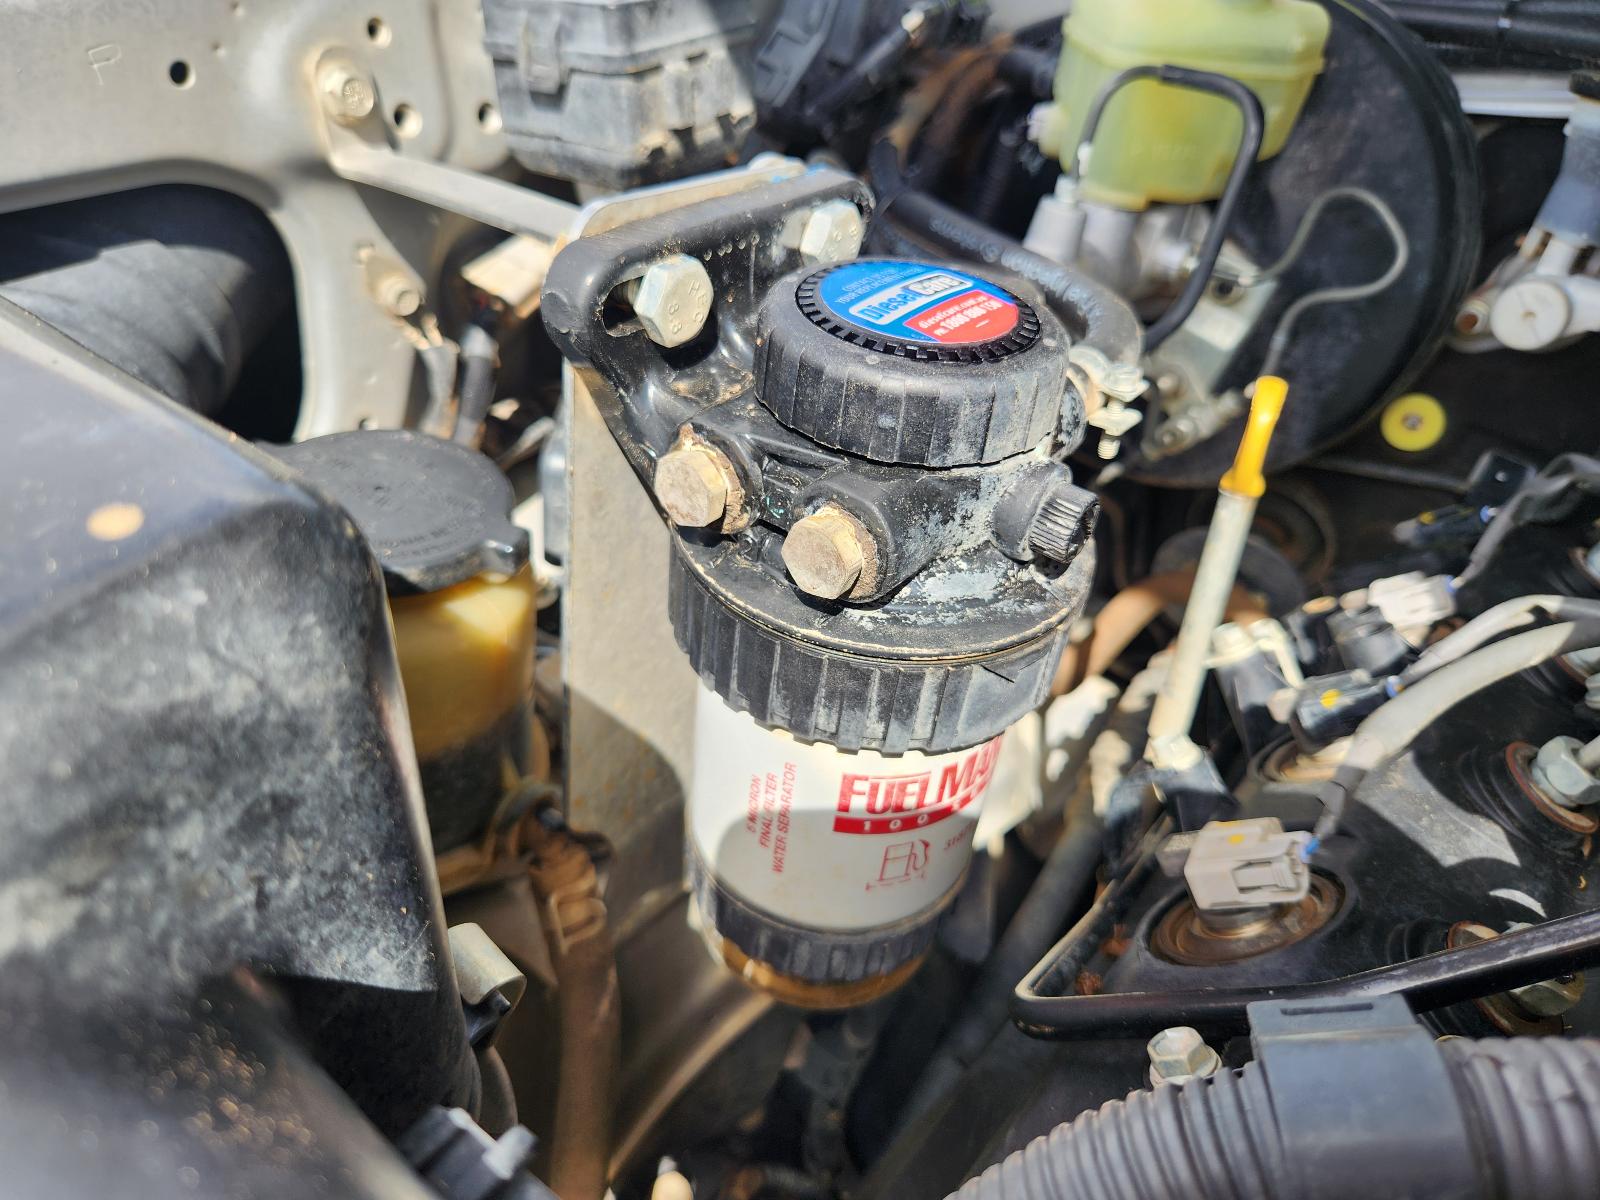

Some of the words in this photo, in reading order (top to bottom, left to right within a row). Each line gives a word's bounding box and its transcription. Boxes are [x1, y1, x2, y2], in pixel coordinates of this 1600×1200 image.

[747, 774, 761, 825] MICRON
[764, 772, 778, 814] FILTER
[777, 761, 797, 834] SEPARATOR
[759, 816, 773, 849] FINAL
[772, 834, 787, 873] WATER
